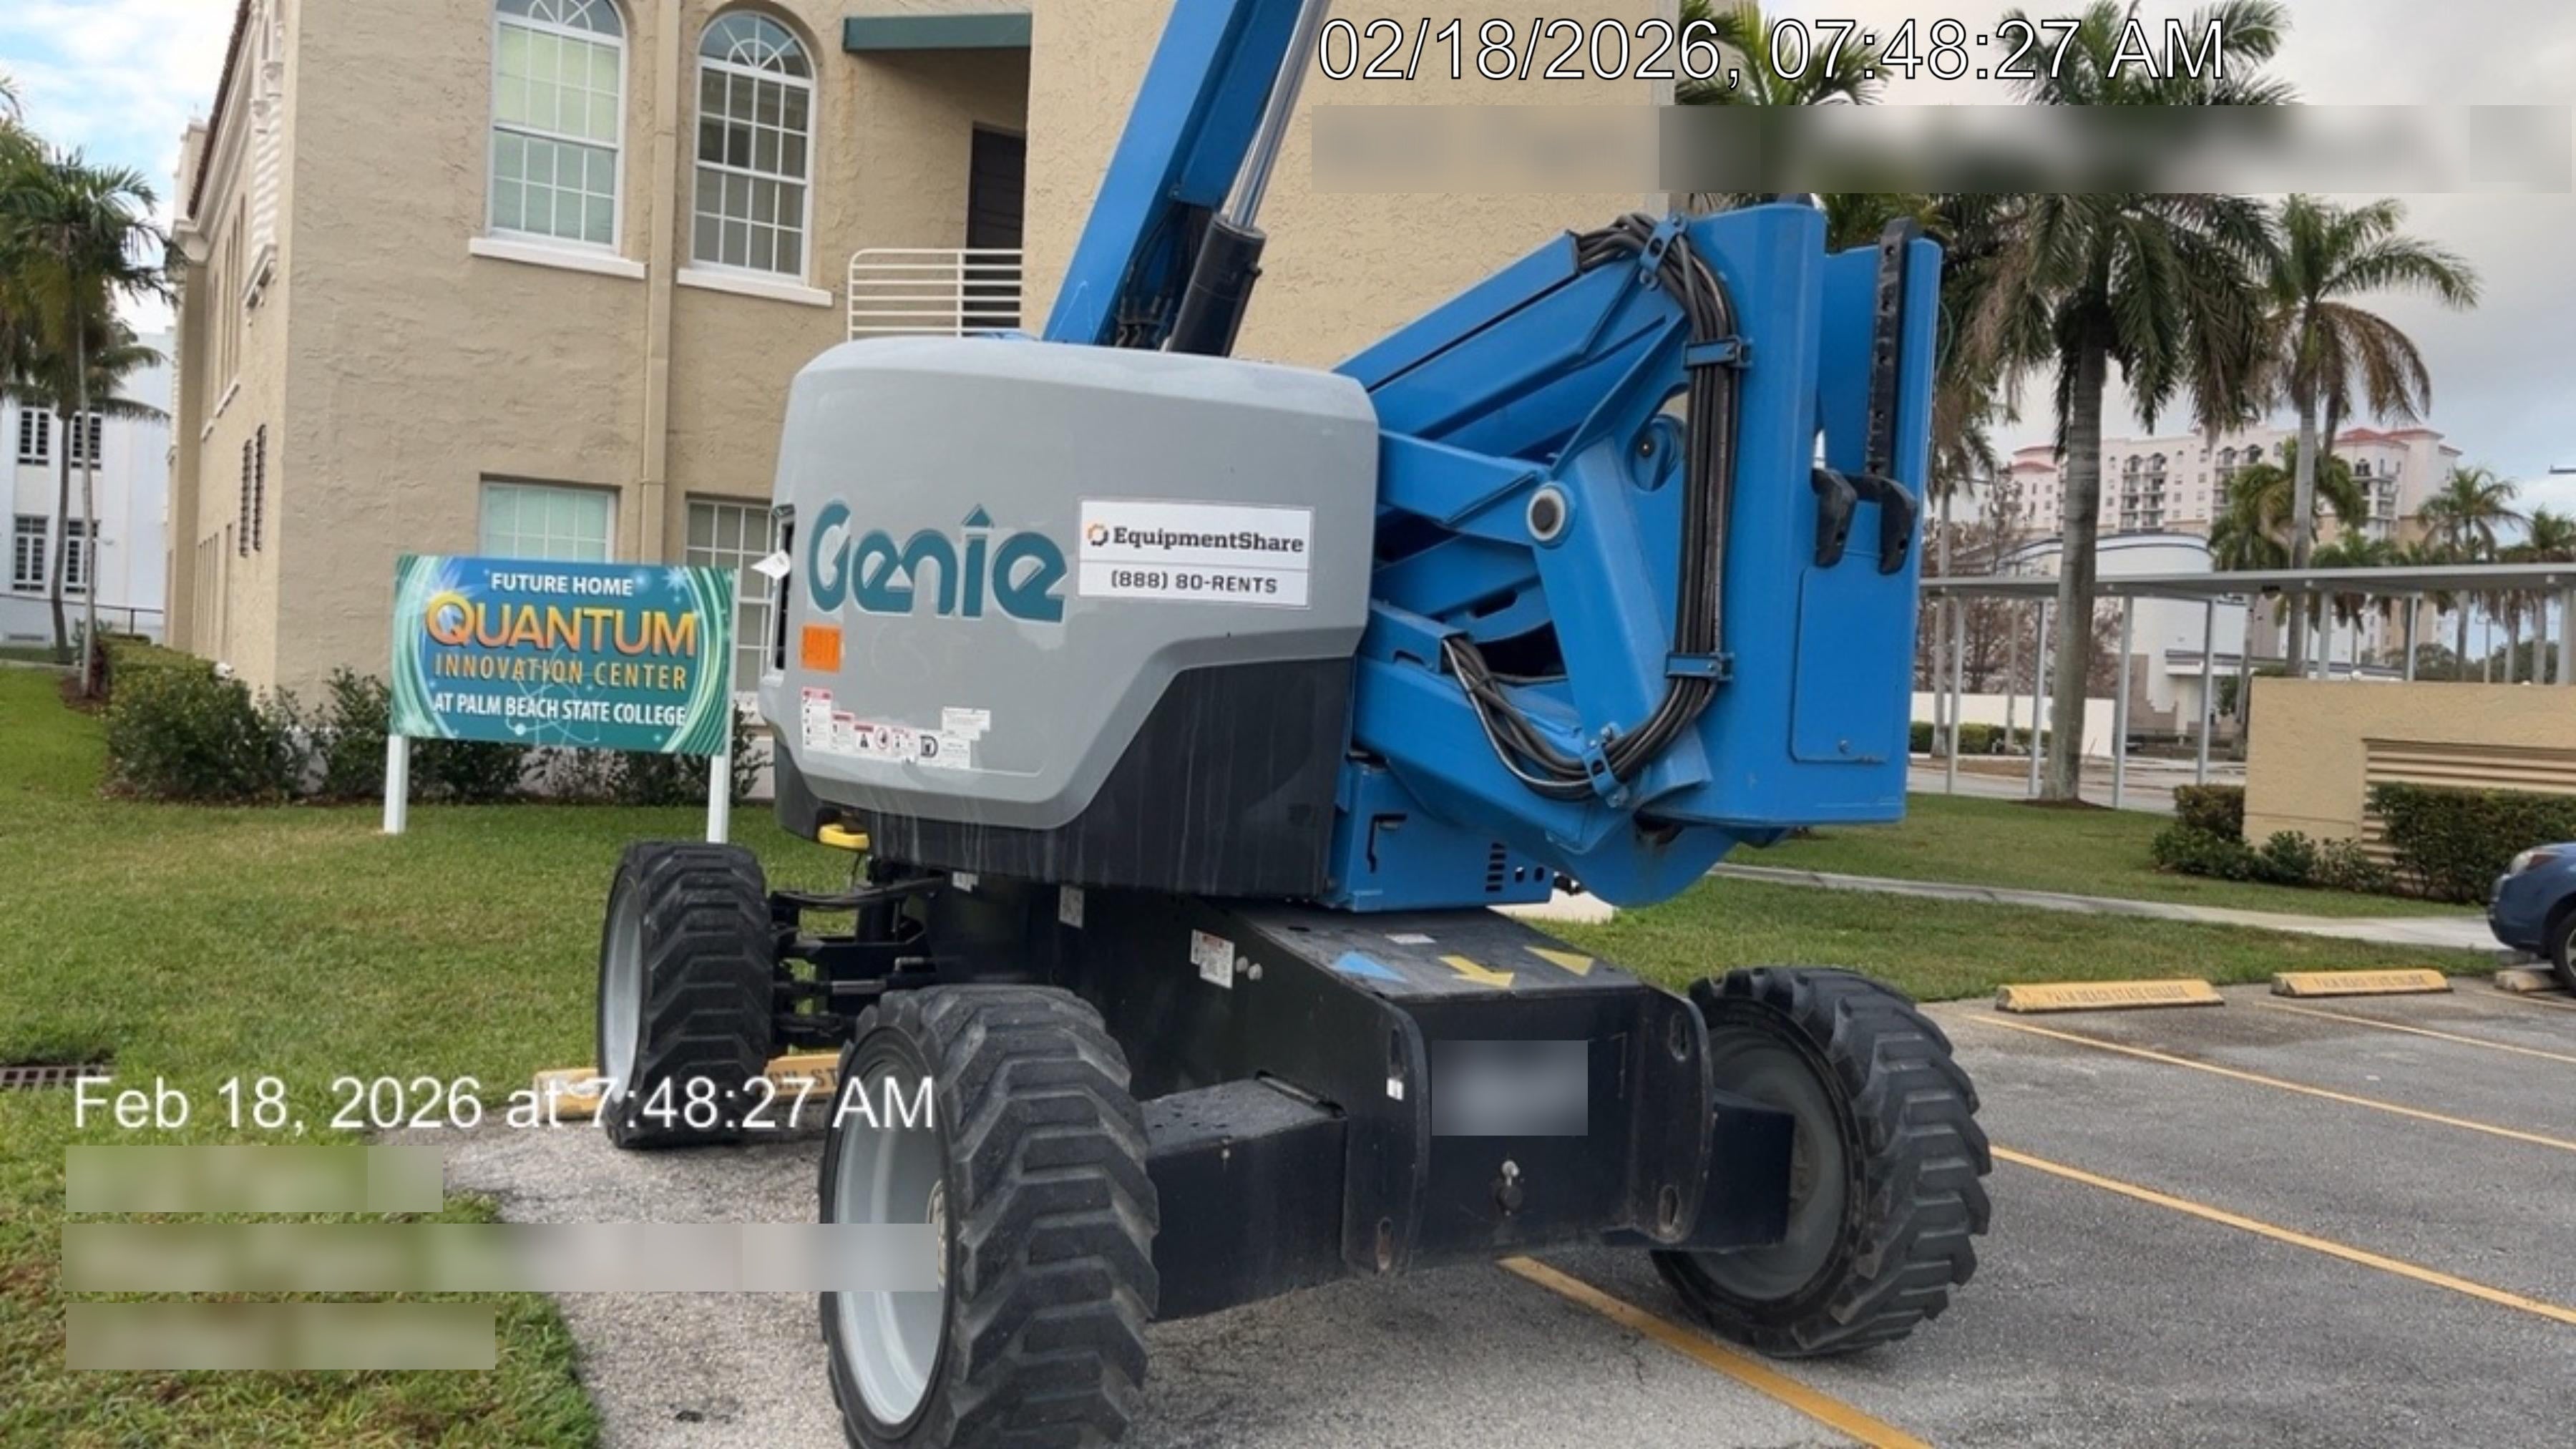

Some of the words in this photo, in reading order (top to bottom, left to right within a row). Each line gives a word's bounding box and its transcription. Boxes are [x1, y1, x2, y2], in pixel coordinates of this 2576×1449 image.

[1113, 526, 1304, 554] EquipmentShare
[808, 499, 1067, 623] Genie
[491, 571, 568, 594] FUTURE
[572, 576, 634, 597] HOME
[1111, 569, 1169, 591] (888)
[1175, 572, 1278, 595] 80-RENTS
[426, 591, 697, 658] QUANTUM
[434, 651, 584, 686] INNOVATION
[592, 660, 688, 691] CENTER
[433, 692, 454, 713] AT
[457, 692, 502, 716] PALM
[504, 695, 560, 720] BEACH
[562, 698, 610, 723] STATE
[613, 701, 687, 727] COLLEGE
